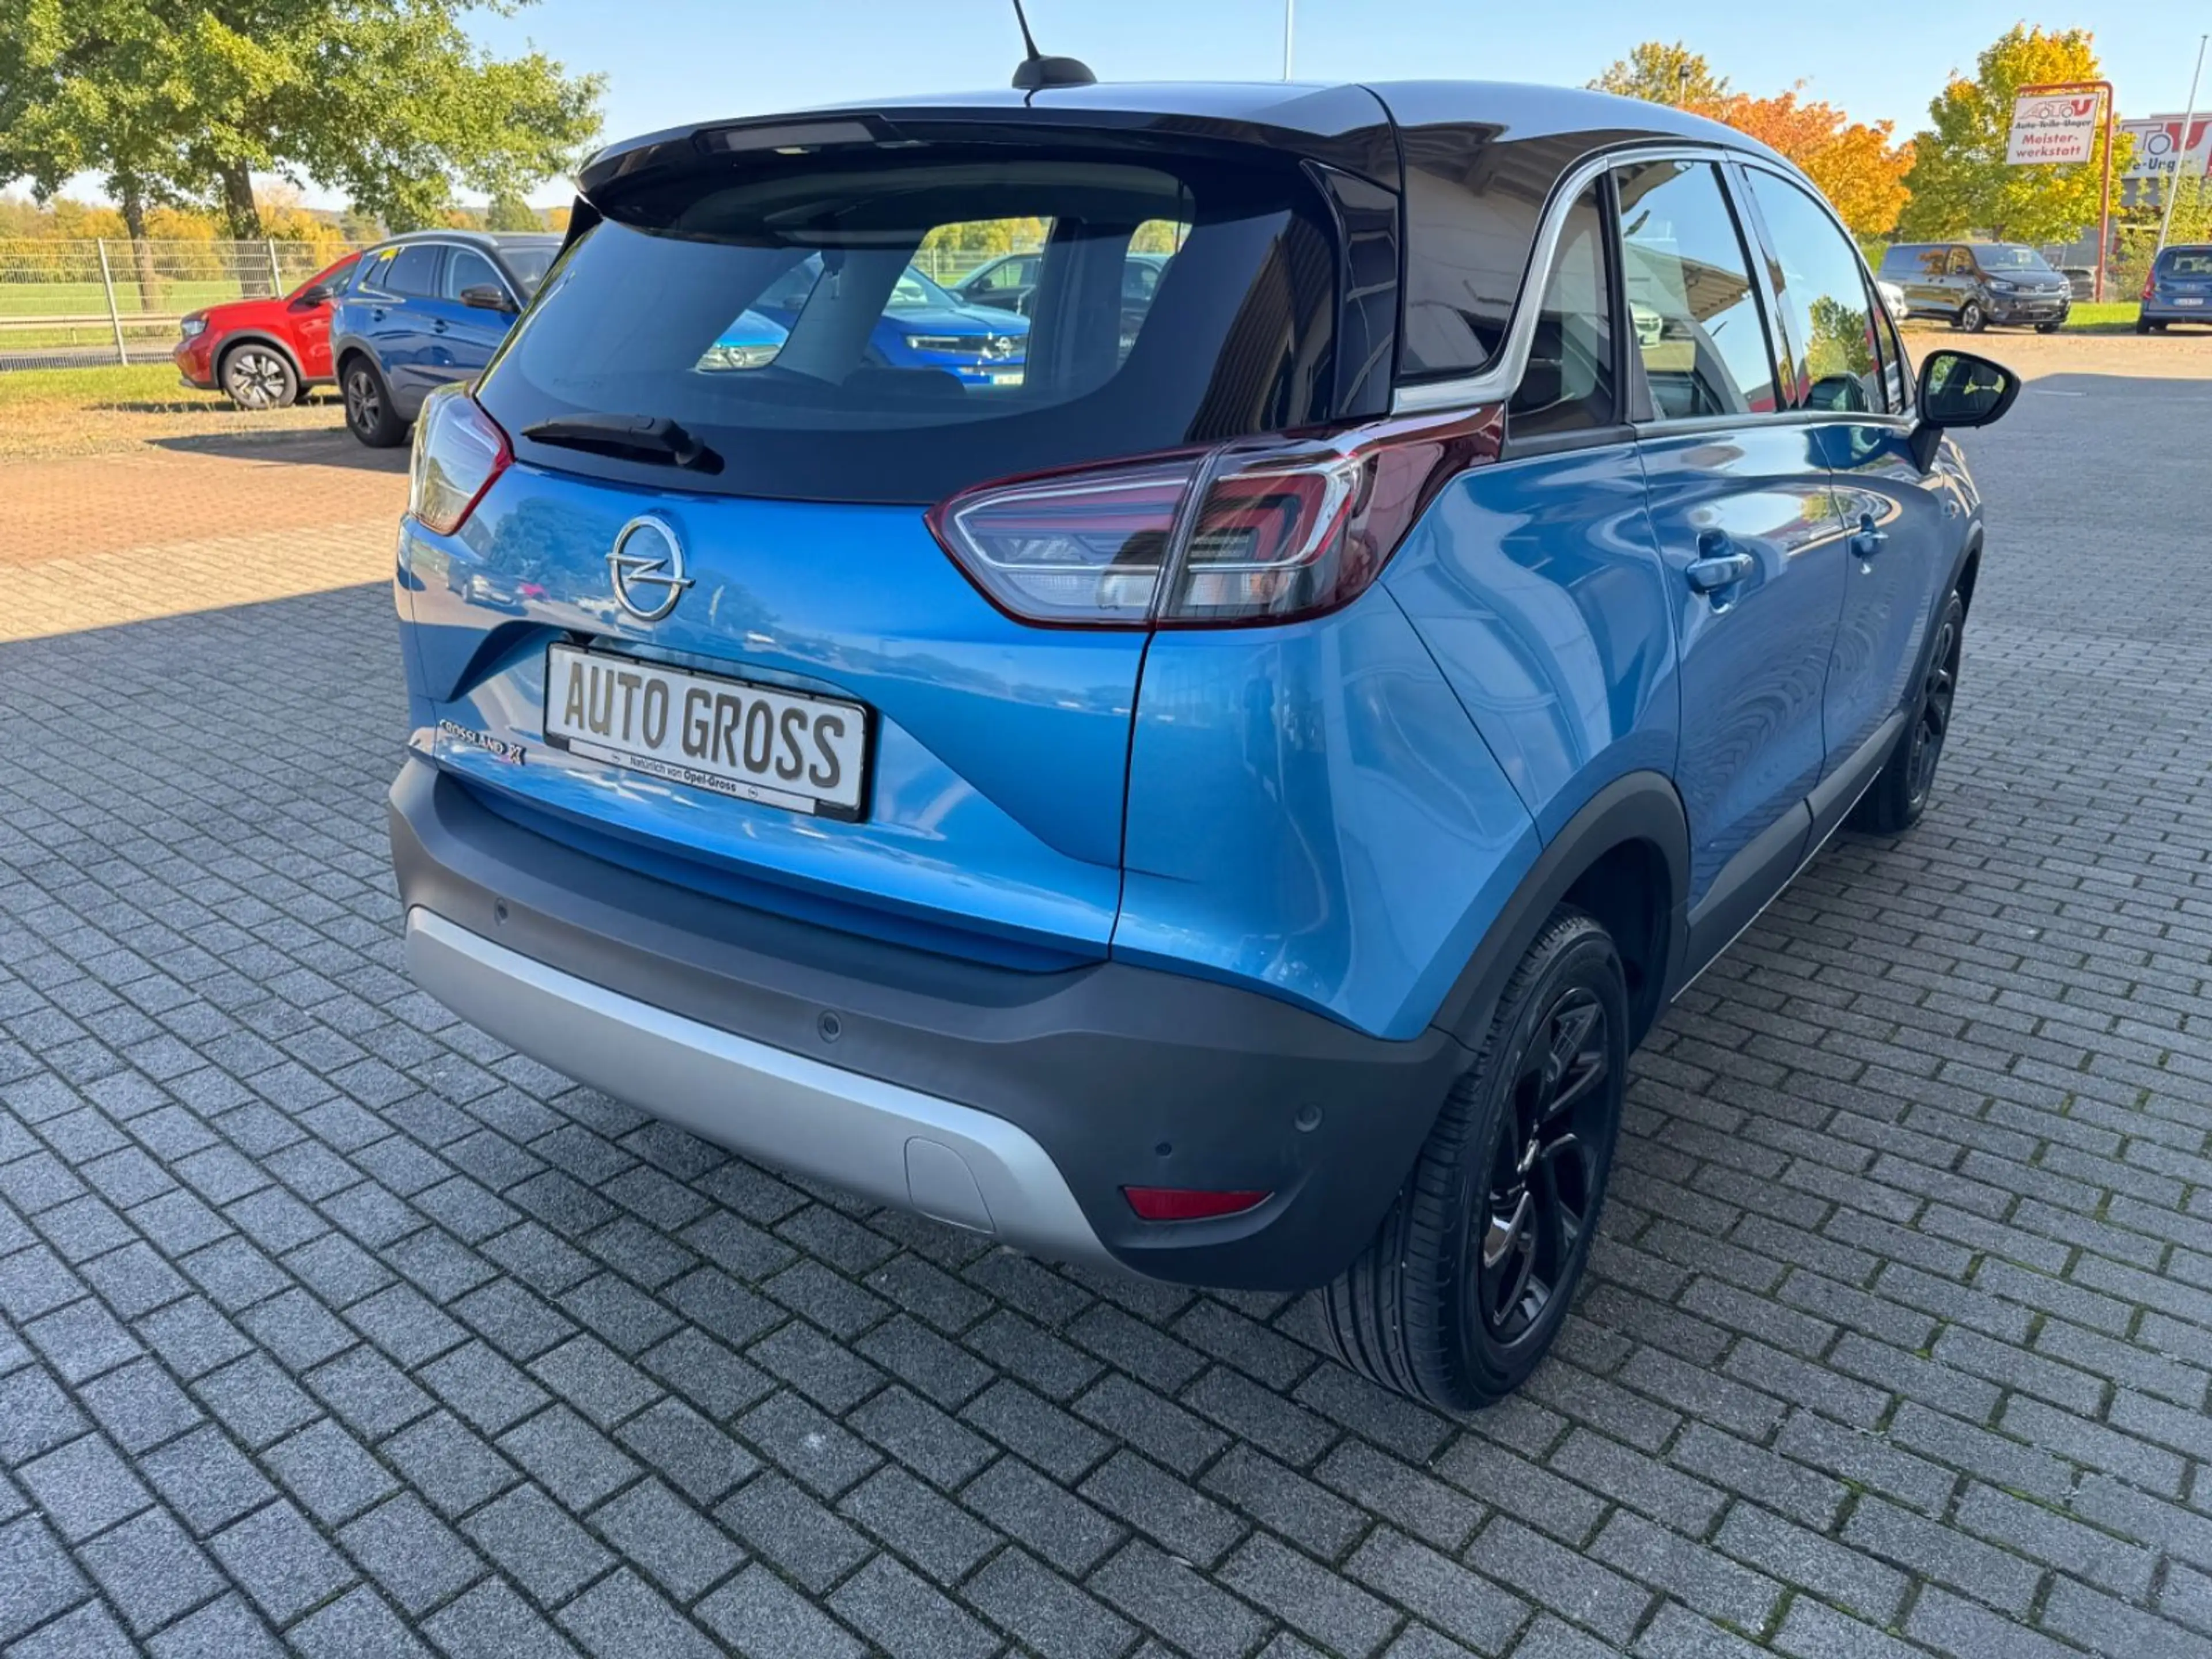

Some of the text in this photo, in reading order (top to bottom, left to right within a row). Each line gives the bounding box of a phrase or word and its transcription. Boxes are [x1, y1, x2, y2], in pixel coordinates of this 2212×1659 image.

[2017, 146, 2081, 158] werkstatt
[2022, 134, 2078, 144] Meister-
[440, 719, 526, 766] CROSSLAND X
[565, 662, 845, 788] AUTO GROSS
[630, 756, 737, 792] Natürlich von Opel-Gross
